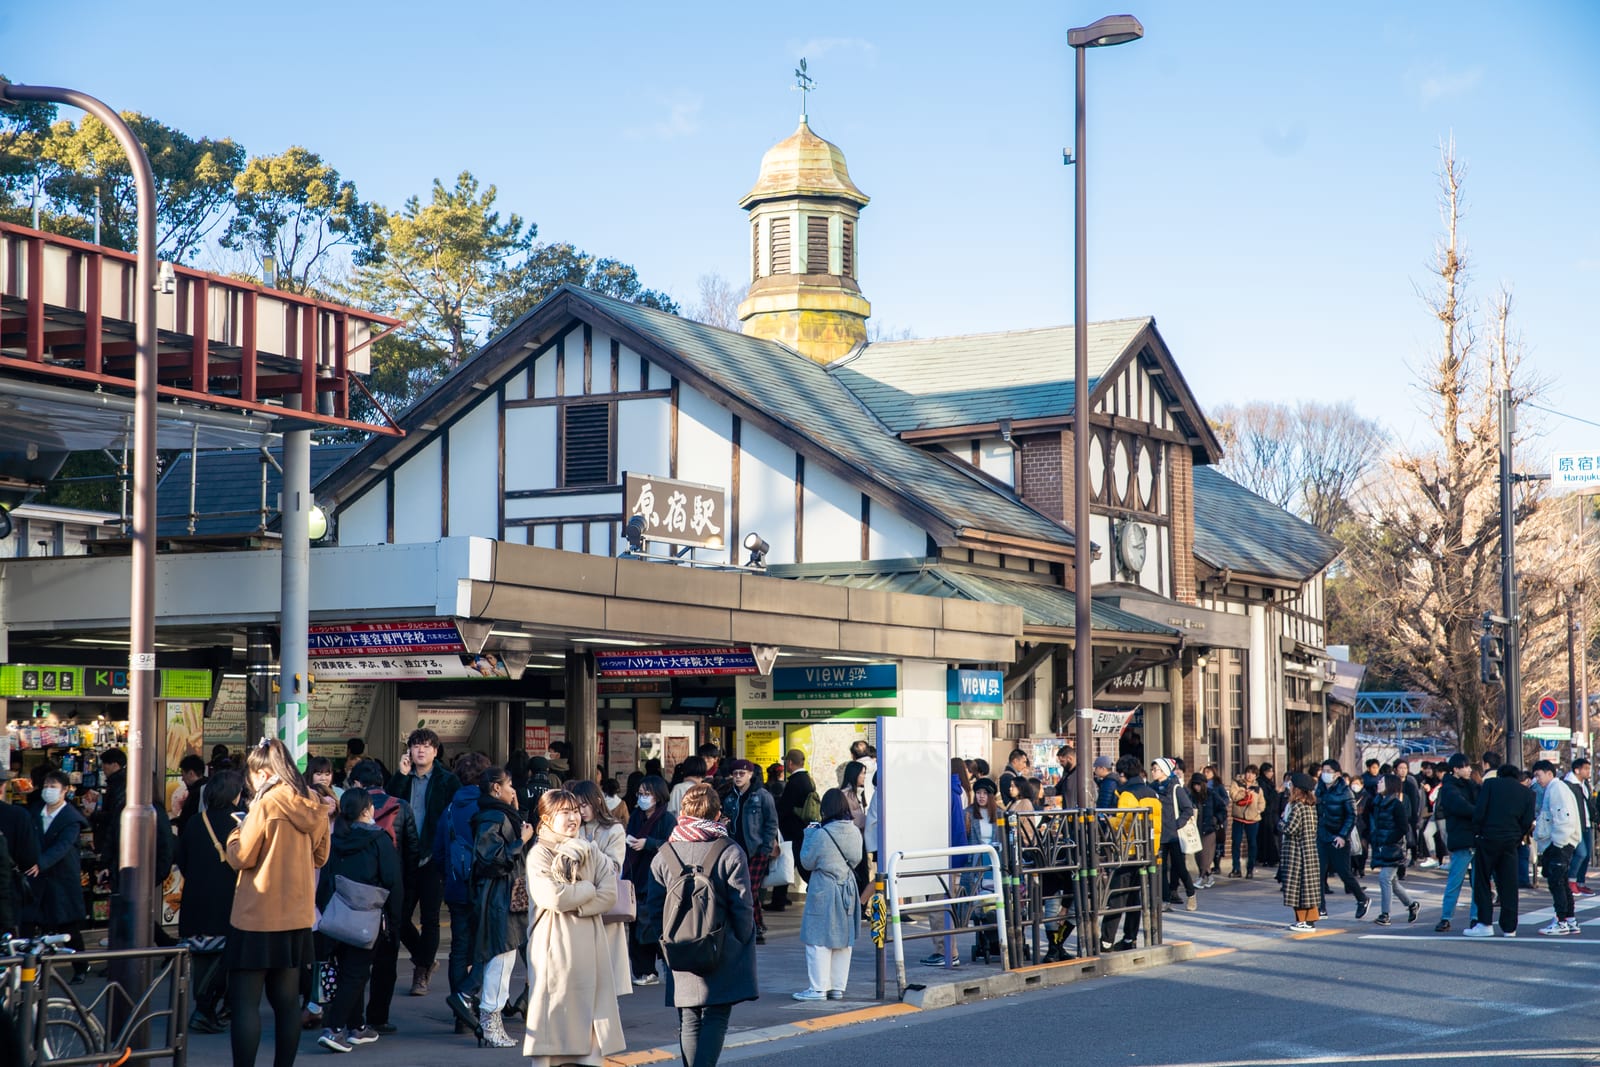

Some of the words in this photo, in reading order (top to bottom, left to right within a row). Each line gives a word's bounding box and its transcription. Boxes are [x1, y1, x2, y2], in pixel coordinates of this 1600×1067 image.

[1559, 456, 1600, 471] 原宿
[632, 482, 721, 536] 原宿駅
[316, 631, 426, 647] ハリウッド美容専門学校
[313, 660, 443, 669] 介護美容を、学ぶ、働く、独立する。
[628, 656, 725, 668] ハリウッド大学院大学
[849, 667, 866, 675] ATM
